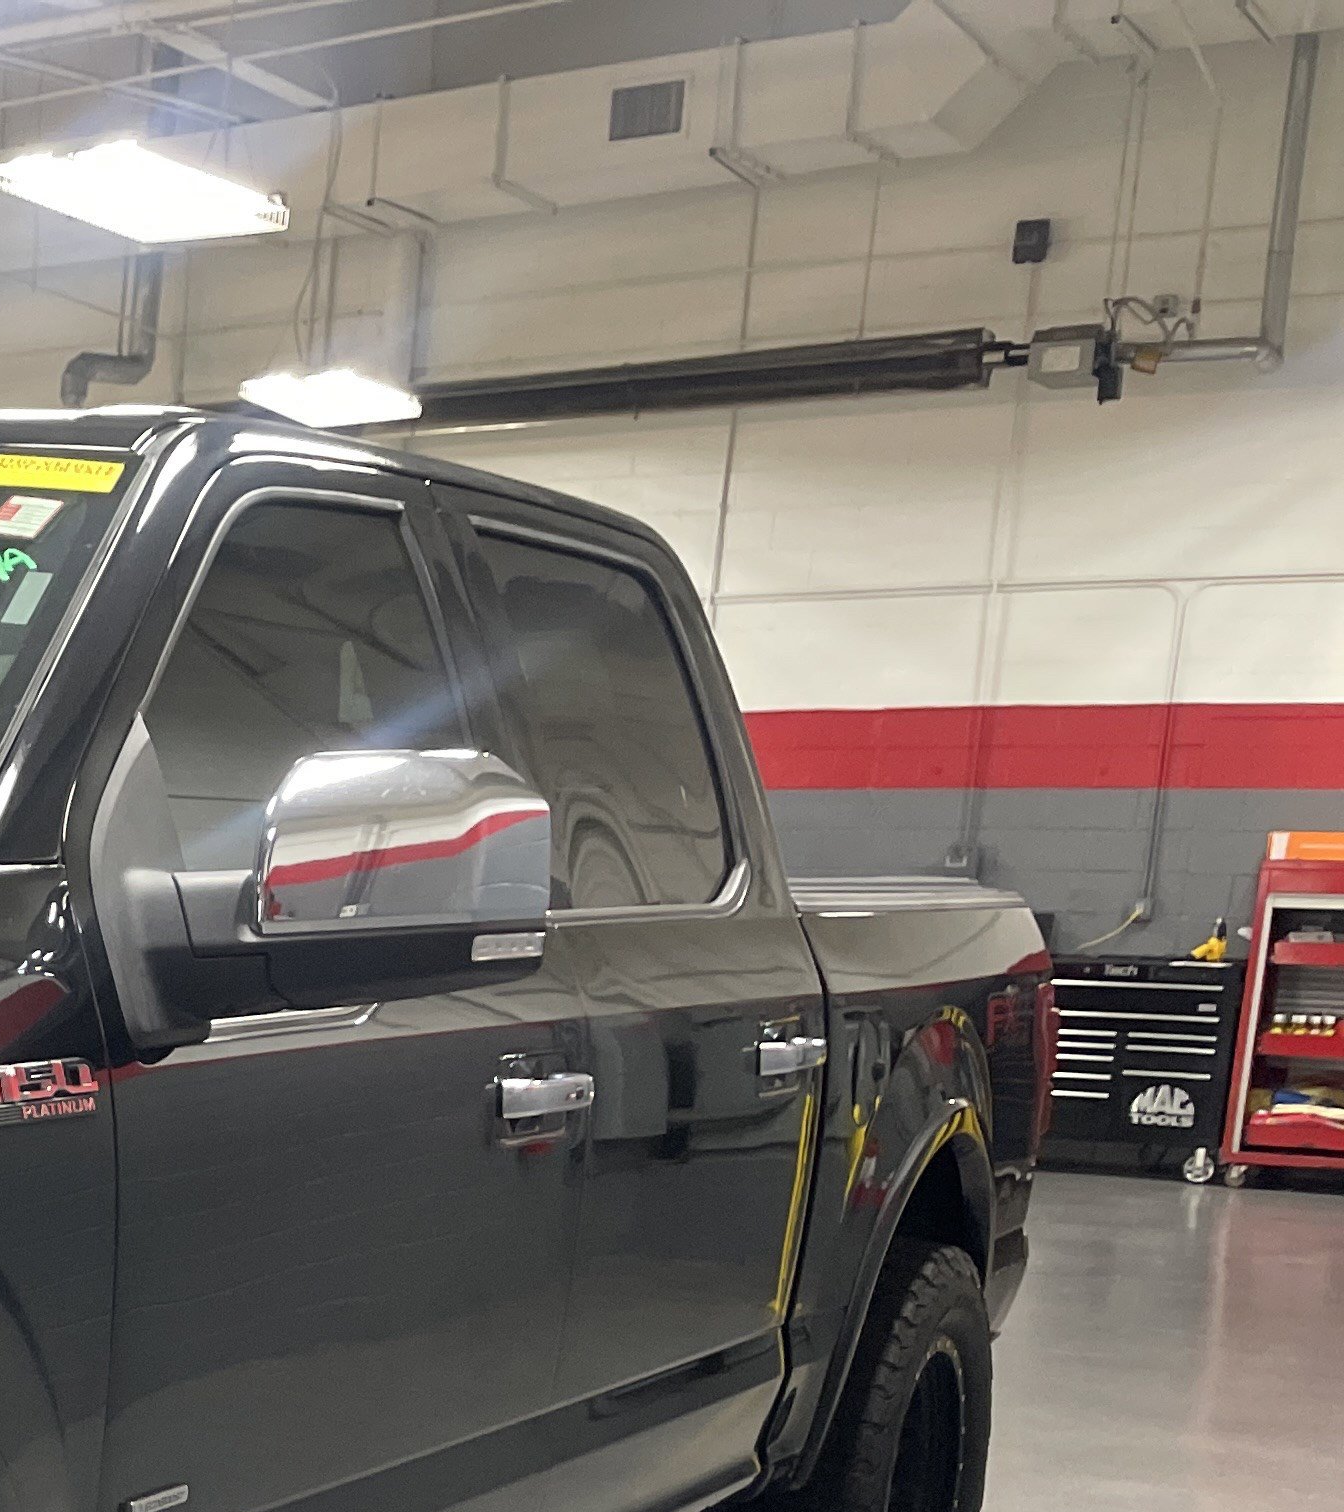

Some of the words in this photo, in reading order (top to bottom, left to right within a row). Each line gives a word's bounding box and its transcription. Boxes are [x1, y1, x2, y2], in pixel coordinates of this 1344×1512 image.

[22, 1096, 97, 1120] PLATINUM
[1130, 1084, 1195, 1115] MAC
[1130, 1113, 1195, 1128] TOOLS
